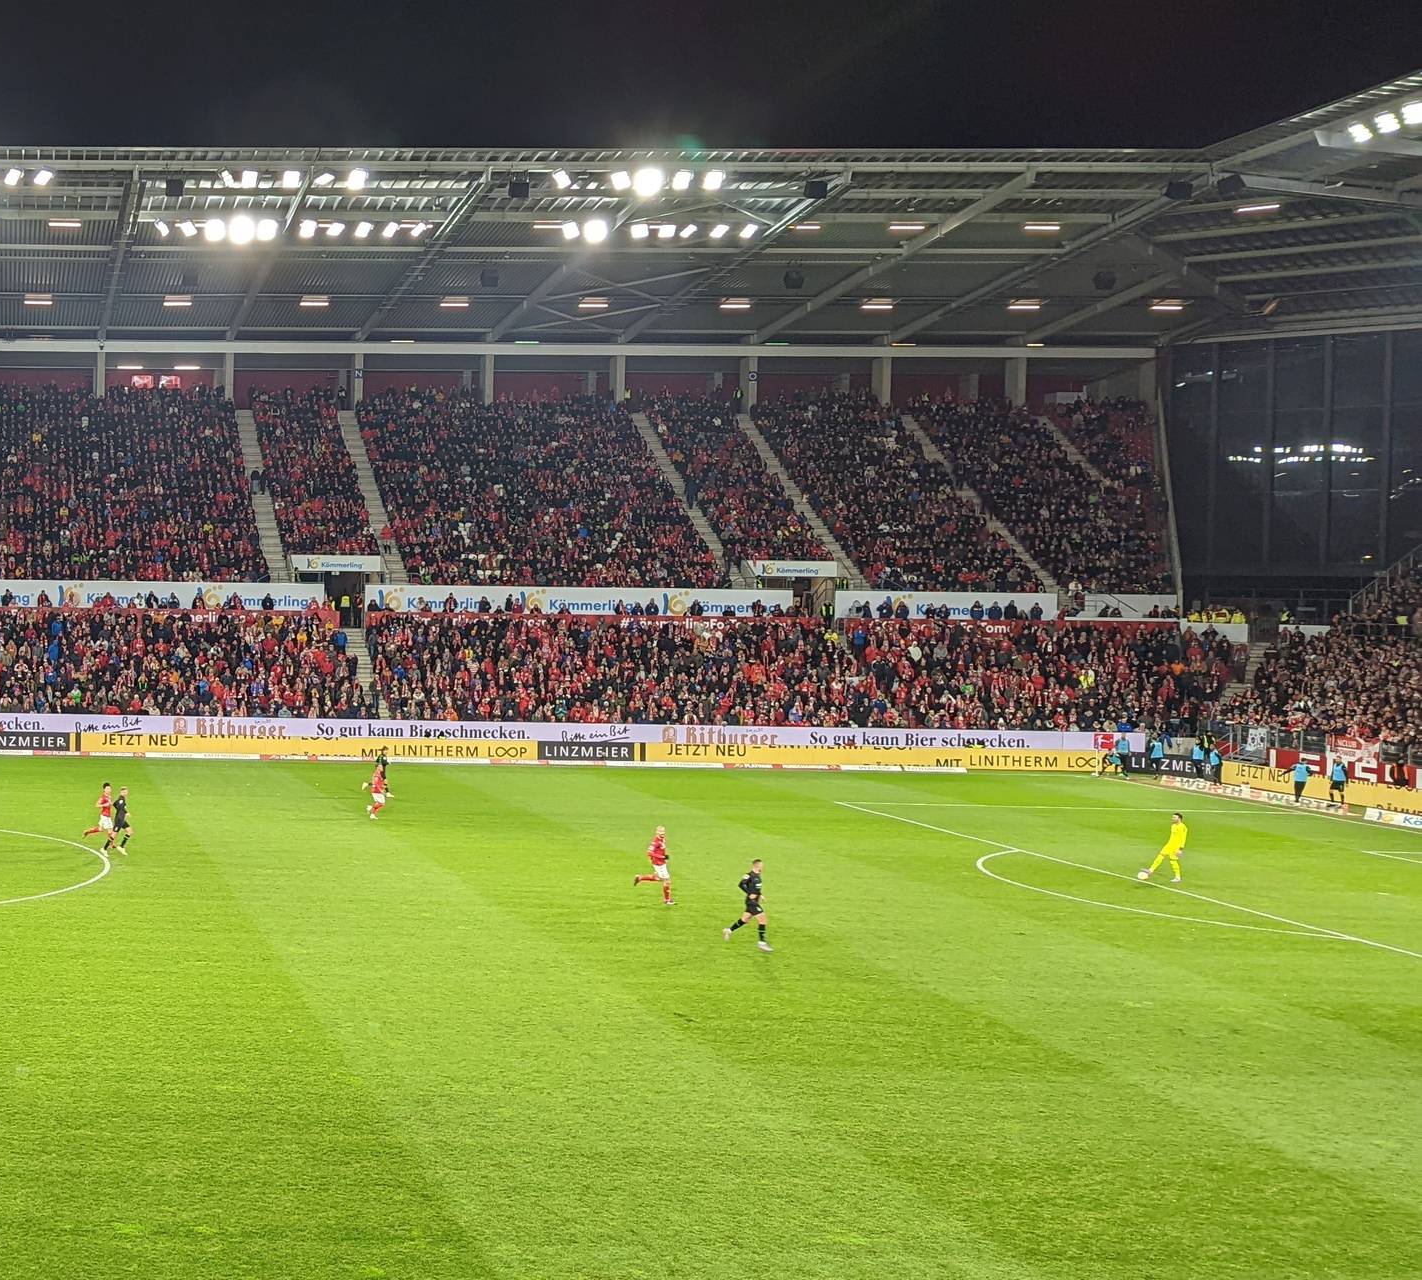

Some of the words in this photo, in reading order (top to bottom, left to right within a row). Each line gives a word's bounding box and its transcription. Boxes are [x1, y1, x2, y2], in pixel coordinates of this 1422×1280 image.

[321, 561, 362, 570] Kömmerling
[776, 567, 819, 577] Kömmerling
[549, 598, 635, 613] Kömmerlig
[317, 723, 334, 735] So
[340, 725, 362, 737] gut
[368, 724, 403, 736] kann
[410, 724, 439, 738] Bir
[446, 725, 530, 739] schmecken.
[102, 735, 143, 746] JETZT
[149, 735, 178, 746] NEU
[810, 731, 831, 745] So
[862, 732, 898, 746] kann
[905, 733, 936, 746] Bier
[394, 745, 478, 757] LINITHERM
[545, 746, 628, 757] LINZMEIER
[668, 744, 710, 756] JETZT
[716, 745, 746, 756] NEU
[936, 757, 962, 767] MIT
[969, 755, 1057, 768] LINITHERM
[1131, 757, 1211, 775] LIZMER
[1236, 764, 1265, 779] JETZT
[1268, 769, 1291, 784] NEU
